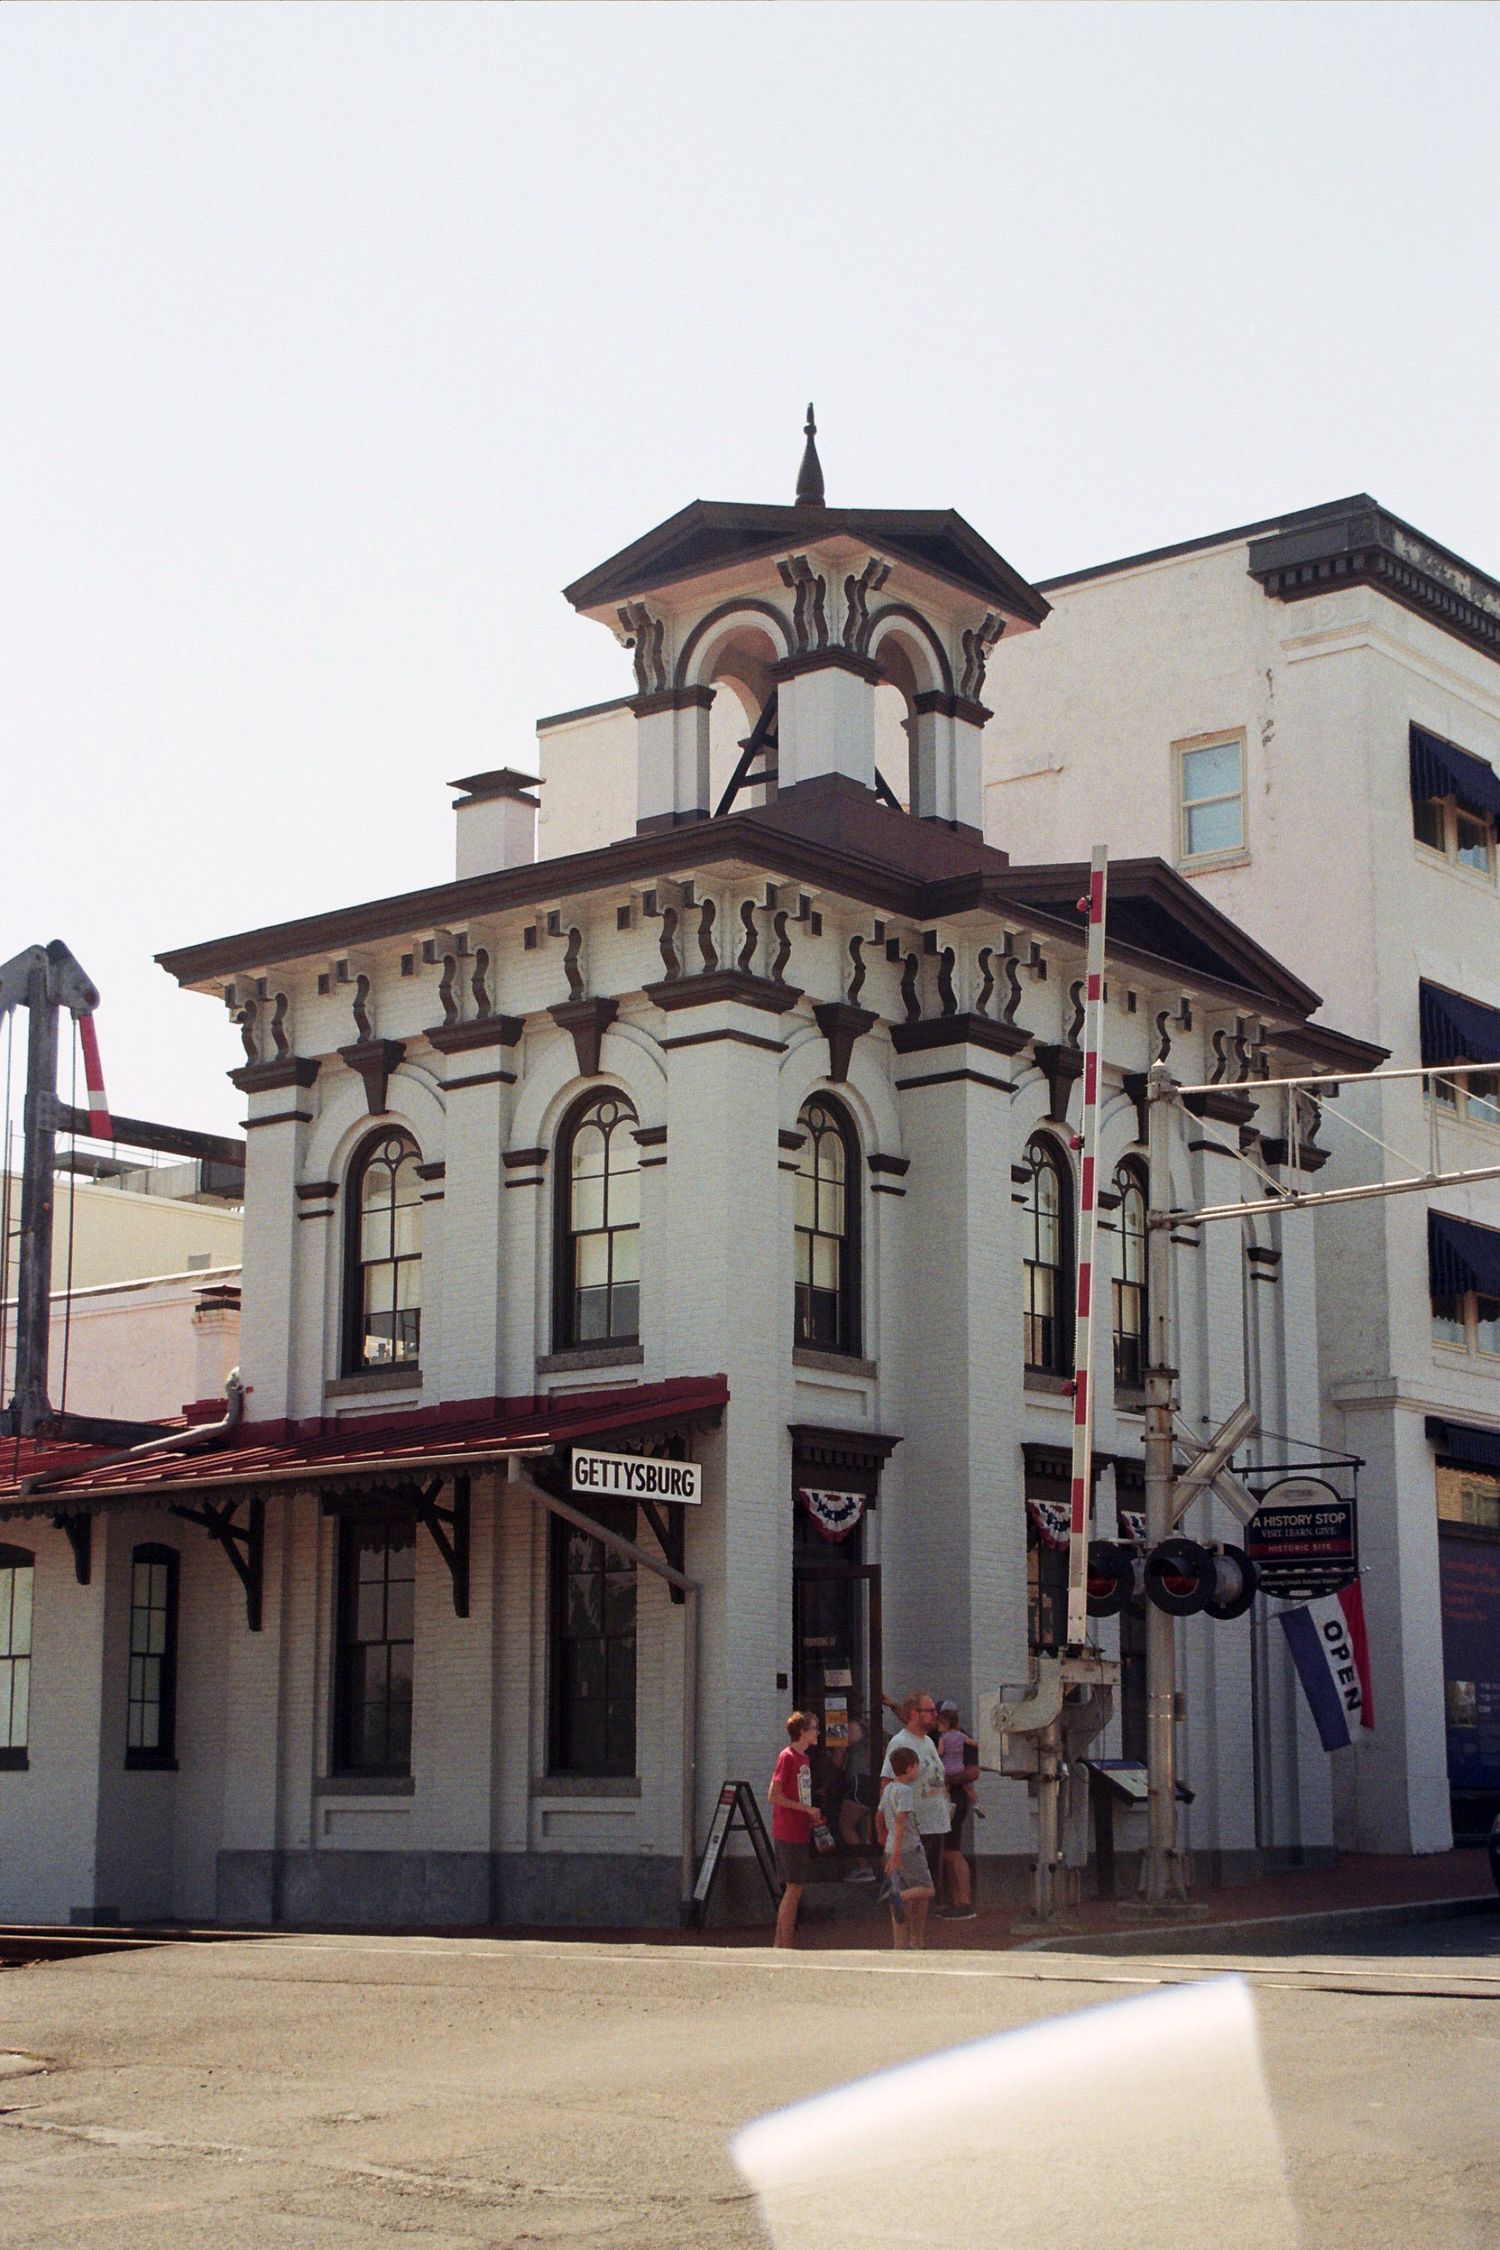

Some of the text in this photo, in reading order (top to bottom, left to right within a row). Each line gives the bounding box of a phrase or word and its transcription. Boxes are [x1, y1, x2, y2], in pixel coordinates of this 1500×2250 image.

[575, 1457, 694, 1497] GETTYSBURG
[1252, 1513, 1345, 1528] A HISTORY STOP
[1268, 1544, 1309, 1552] HISTORIC
[1323, 1620, 1362, 1711] OPEN
